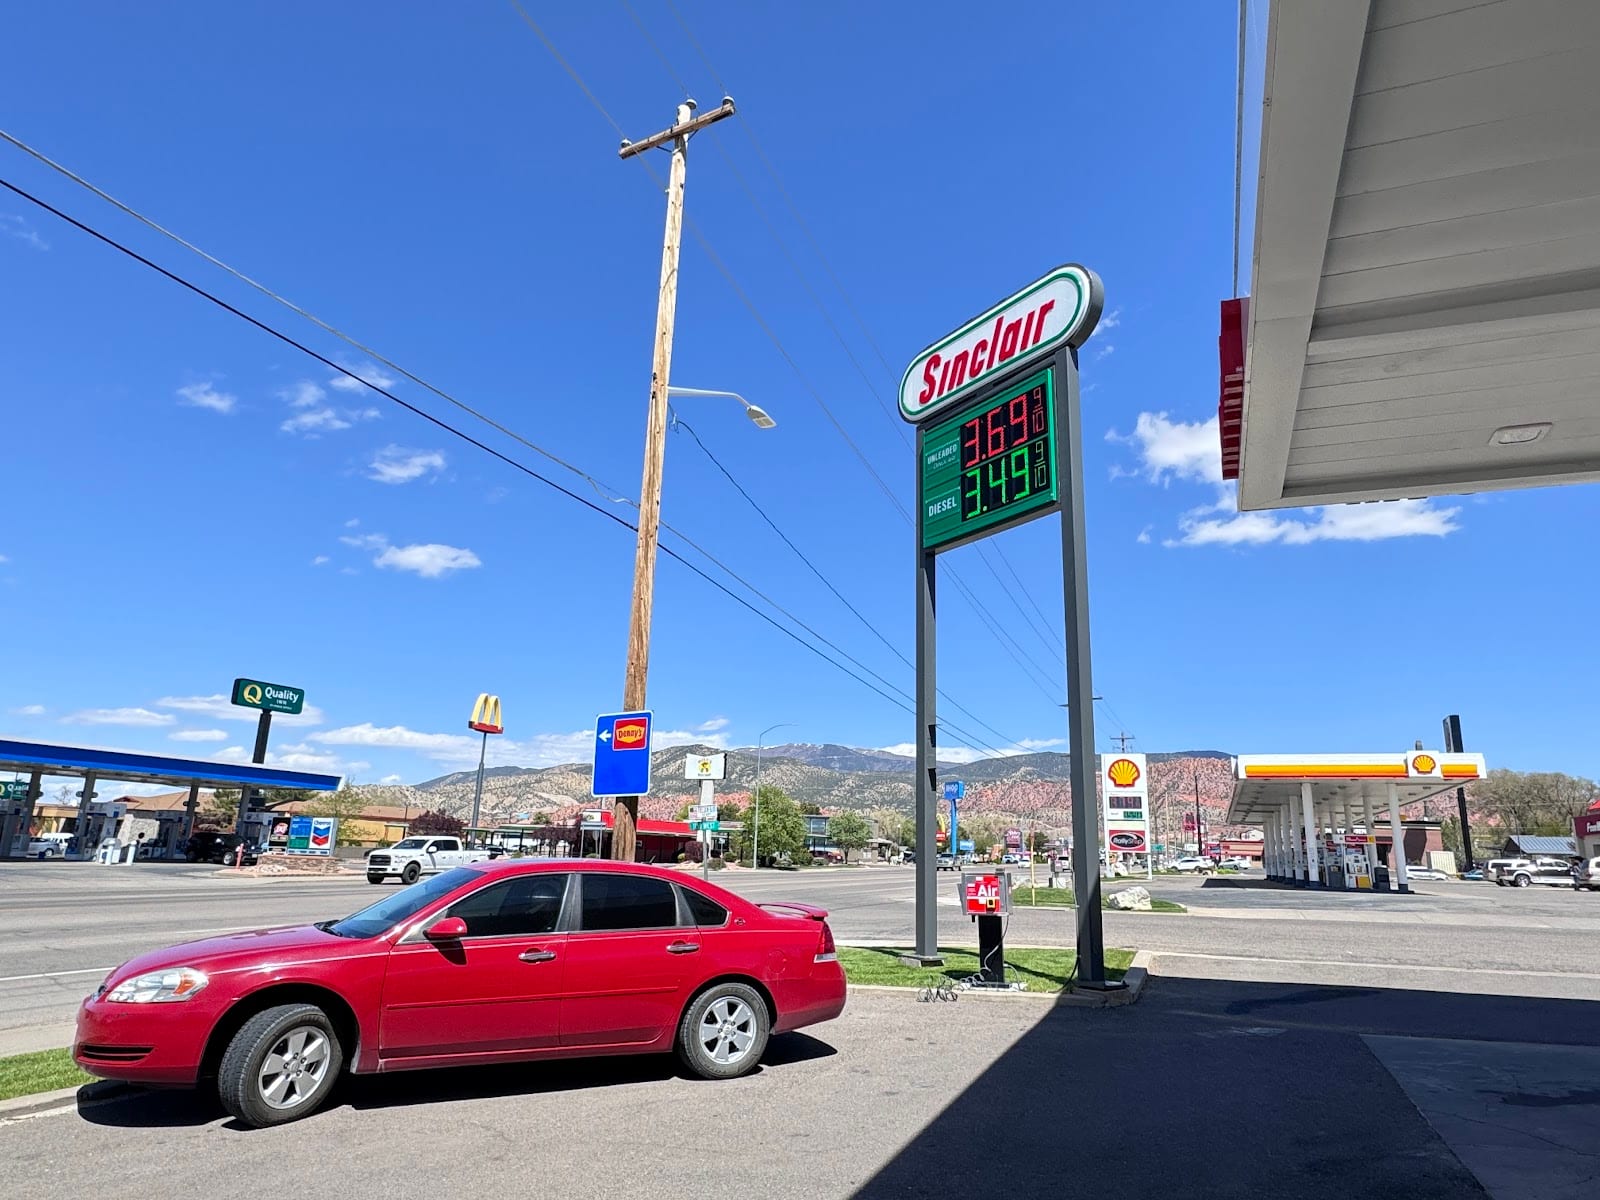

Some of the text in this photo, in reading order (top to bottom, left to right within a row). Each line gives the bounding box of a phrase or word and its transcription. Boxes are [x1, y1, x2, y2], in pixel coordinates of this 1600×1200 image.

[918, 299, 1056, 405] Sinclair
[927, 393, 1028, 468] UNLEADED 3.69
[928, 447, 1030, 519] DIESEL 3.49
[265, 686, 299, 703] Quality
[618, 728, 642, 738] Denny's
[978, 885, 998, 897] Air
